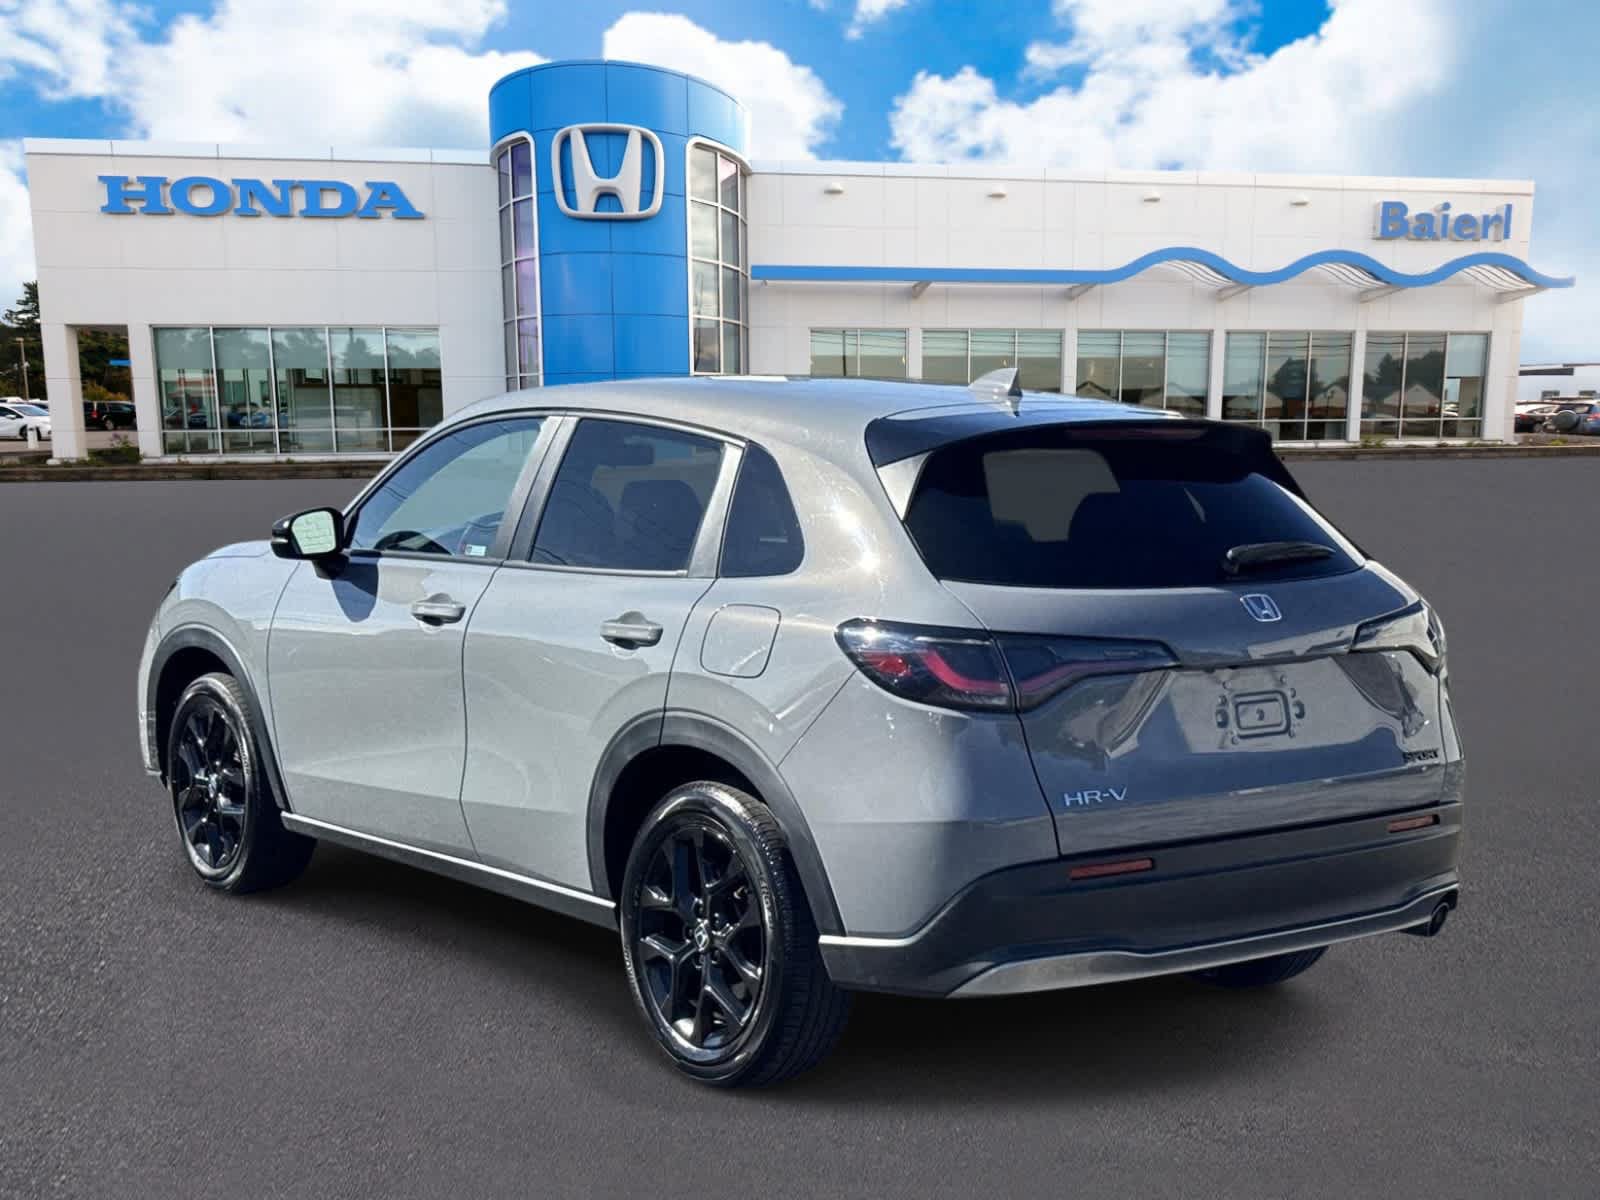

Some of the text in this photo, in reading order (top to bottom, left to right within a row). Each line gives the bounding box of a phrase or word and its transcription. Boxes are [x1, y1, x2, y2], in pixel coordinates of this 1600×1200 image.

[97, 175, 425, 220] HONDA
[1376, 200, 1513, 241] Baierl
[1063, 787, 1128, 807] HR-V
